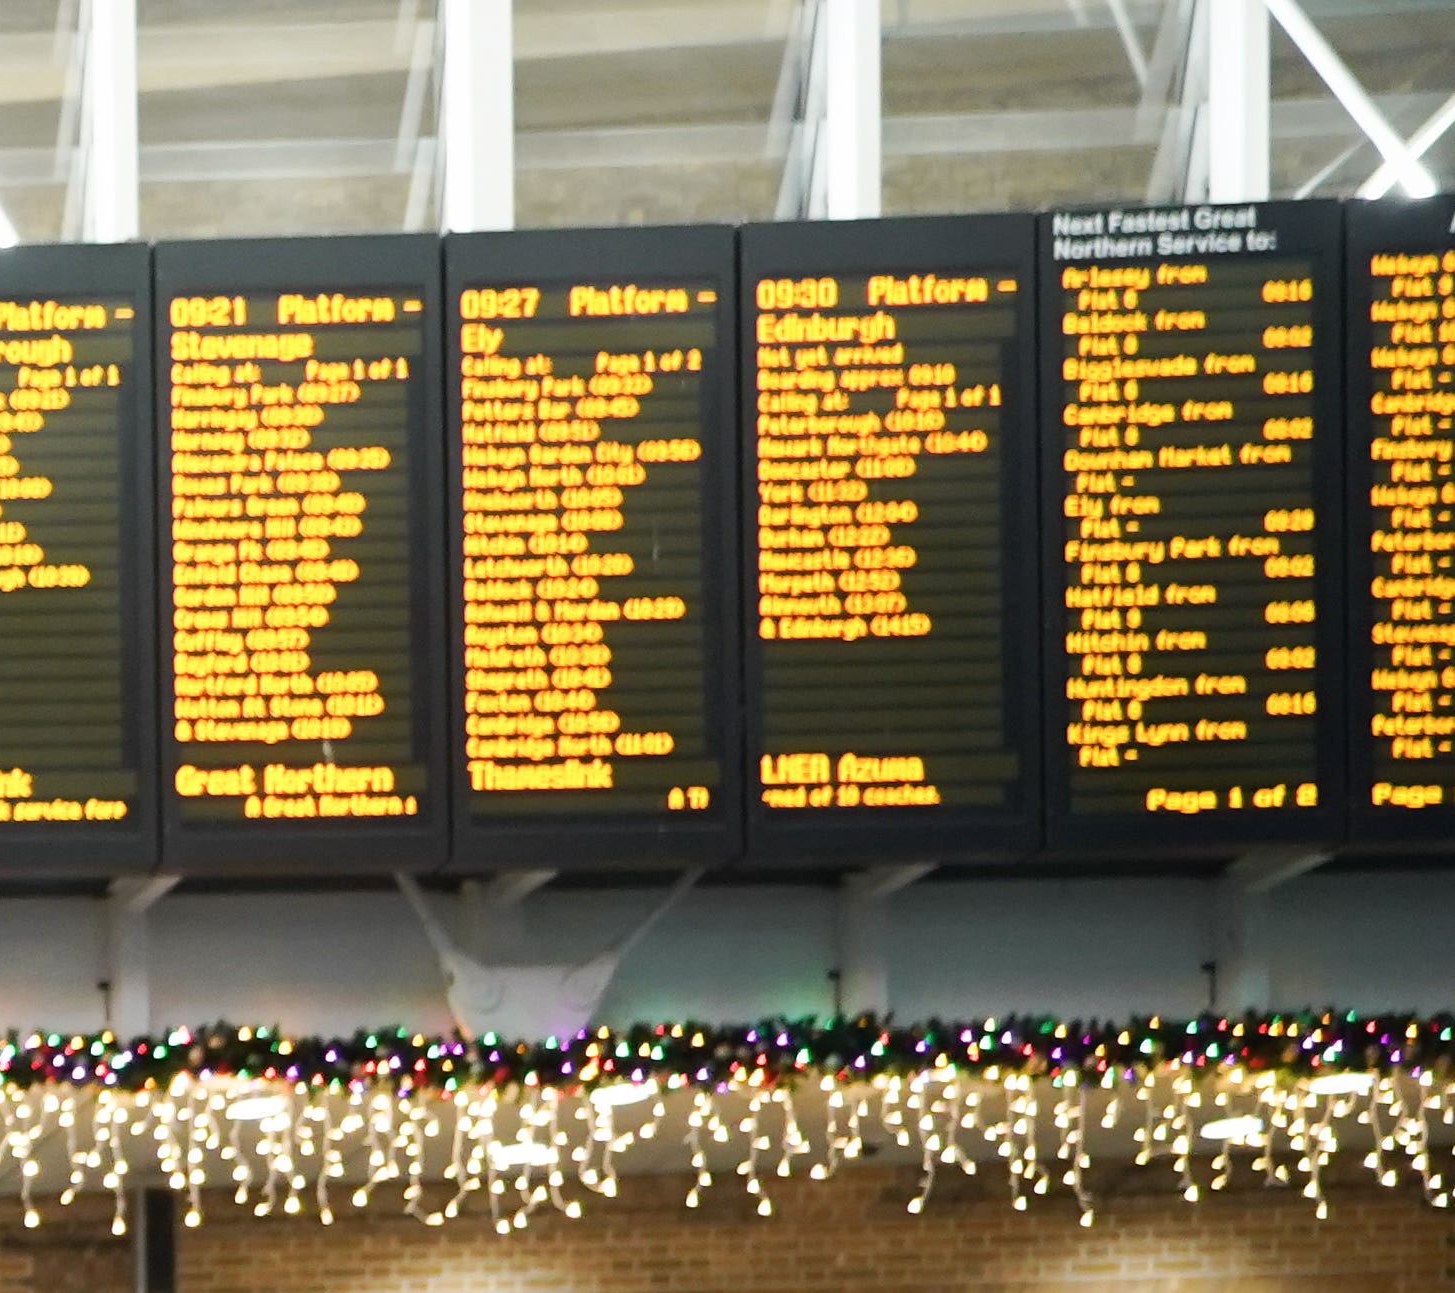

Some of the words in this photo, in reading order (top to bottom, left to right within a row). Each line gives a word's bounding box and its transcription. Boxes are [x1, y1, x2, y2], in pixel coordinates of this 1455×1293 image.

[1053, 210, 1104, 236] Next
[1108, 207, 1190, 234] Fastest
[1193, 205, 1257, 230] Great
[1053, 235, 1153, 261] Northern
[1156, 231, 1243, 256] Service
[460, 288, 540, 319] 09:27
[569, 285, 688, 316] Platform
[756, 278, 838, 310] 09:30
[868, 274, 988, 306] Platform
[277, 294, 395, 325] Platform
[461, 323, 505, 356] Ely
[757, 311, 896, 347] Edinburgh
[171, 331, 314, 362] Stevenage
[175, 765, 257, 796] Great
[264, 763, 394, 796] Northern
[467, 758, 612, 790] Thameslink
[1147, 789, 1216, 813] Page
[1229, 787, 1242, 808] 1
[1253, 784, 1285, 807] of
